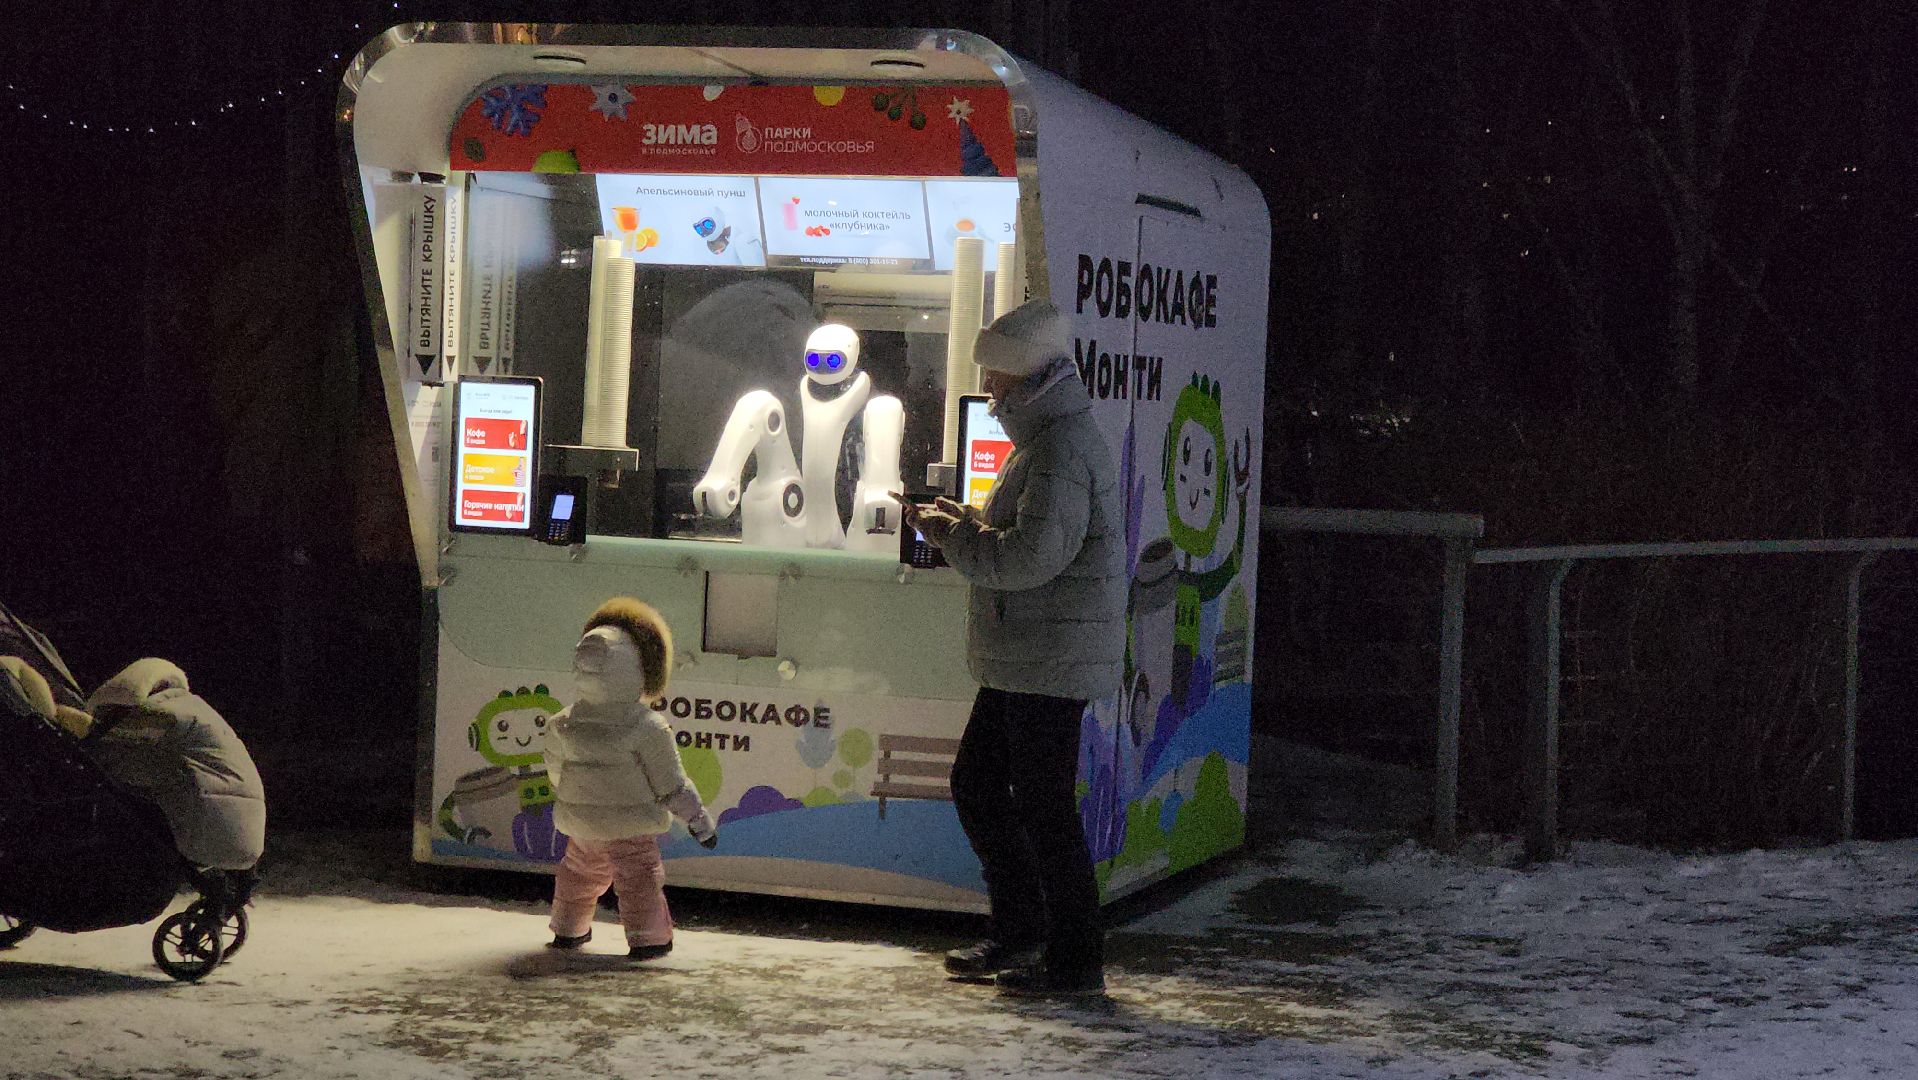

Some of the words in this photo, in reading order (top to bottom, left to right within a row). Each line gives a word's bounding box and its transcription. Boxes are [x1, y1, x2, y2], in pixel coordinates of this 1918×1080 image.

[764, 127, 811, 139] ПАРКИ
[764, 140, 875, 154] ПОДМОСКОВЬЯ
[636, 186, 714, 197] Апельсиновый
[717, 189, 746, 199] пунш
[804, 208, 859, 220] молочный
[862, 210, 911, 220] коктейль
[422, 194, 436, 262] КРЫШКУ
[448, 197, 457, 264] КРЫШКУ
[830, 220, 890, 232] «клубника»
[1076, 253, 1218, 330] РОБОКАФЕ
[419, 268, 433, 348] ВЫТЯНИТЕ
[447, 270, 456, 348] ВЫТЯНИТЕ
[466, 428, 486, 439] Кофе
[974, 451, 996, 462] Кофе
[464, 500, 492, 510] Горячие
[674, 729, 750, 752] онти
